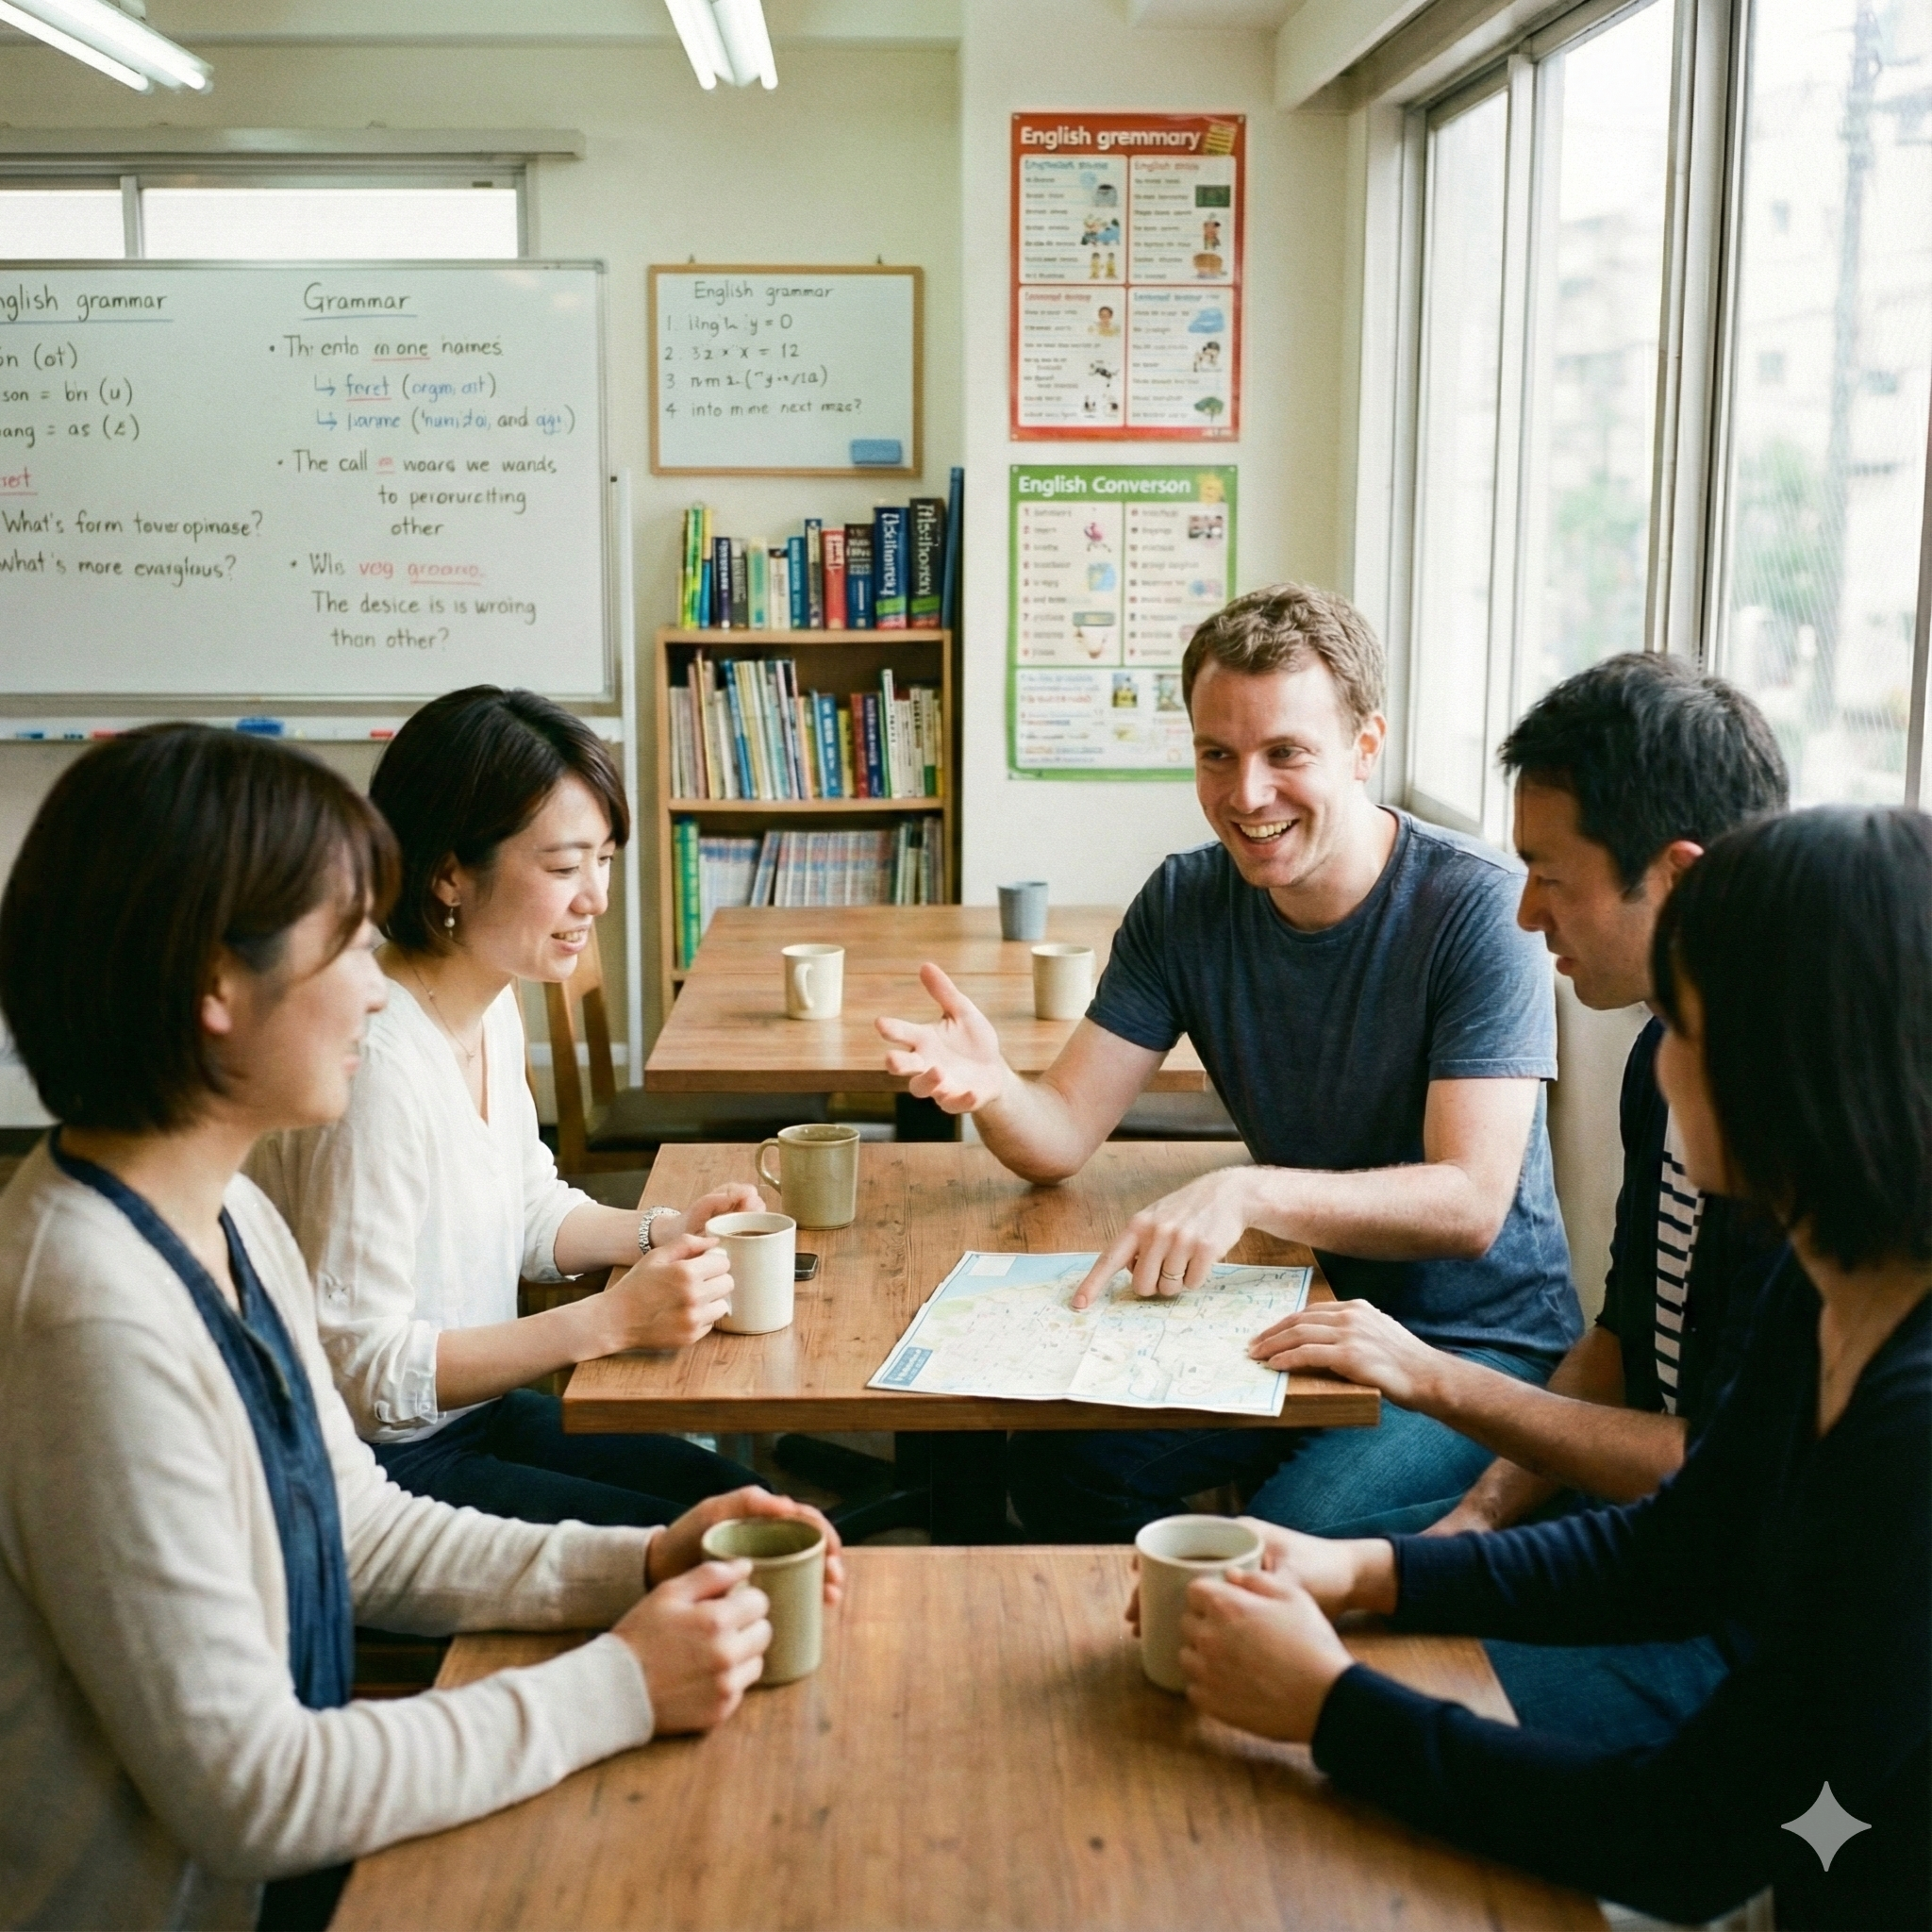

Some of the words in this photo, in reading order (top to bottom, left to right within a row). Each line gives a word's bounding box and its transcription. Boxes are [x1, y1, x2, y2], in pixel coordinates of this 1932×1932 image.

[1020, 125, 1091, 150] English
[1097, 131, 1201, 151] gremmary
[304, 282, 410, 312] Grammar
[694, 281, 753, 306] English
[766, 287, 834, 306] grammar
[76, 293, 167, 322] grammar
[396, 342, 428, 357] one
[781, 342, 799, 358] 12
[665, 402, 677, 419] 4
[0, 425, 35, 448] ang
[293, 448, 328, 472] The
[339, 448, 368, 471] call
[466, 458, 491, 472] we
[378, 484, 398, 505] to
[1018, 475, 1087, 497] English
[1091, 475, 1191, 493] Converson
[2, 509, 65, 535] What's
[75, 509, 124, 534] form
[391, 516, 445, 536] other
[78, 561, 124, 575] more
[311, 590, 349, 613] The
[429, 596, 445, 614] is
[330, 626, 376, 649] than
[386, 626, 450, 652] other?
